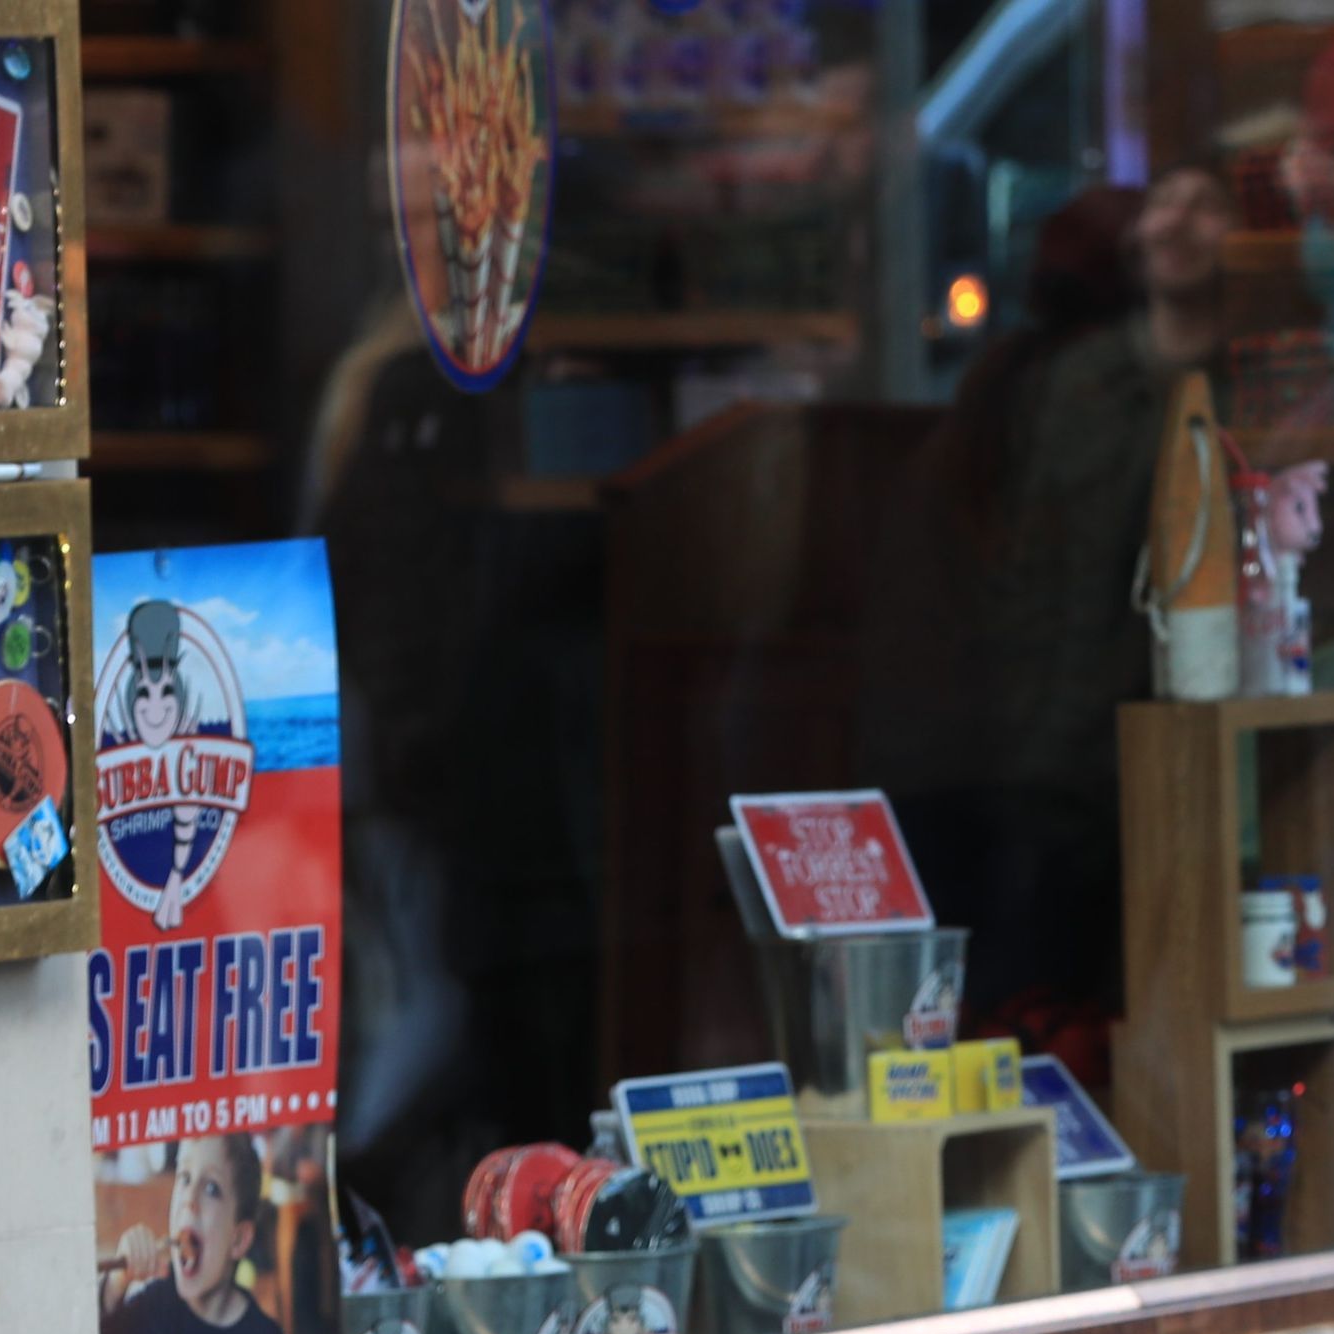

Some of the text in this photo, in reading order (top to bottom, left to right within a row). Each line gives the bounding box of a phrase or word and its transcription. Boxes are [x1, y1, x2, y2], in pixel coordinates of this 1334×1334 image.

[177, 741, 247, 800] GUMP
[109, 808, 174, 841] SHRIMP
[122, 937, 206, 1092] EAT
[209, 924, 325, 1080] FREE
[116, 1109, 140, 1144] 11
[145, 1103, 178, 1137] AM
[180, 1099, 210, 1133] TO
[214, 1098, 230, 1131] 5
[234, 1093, 267, 1128] PM
